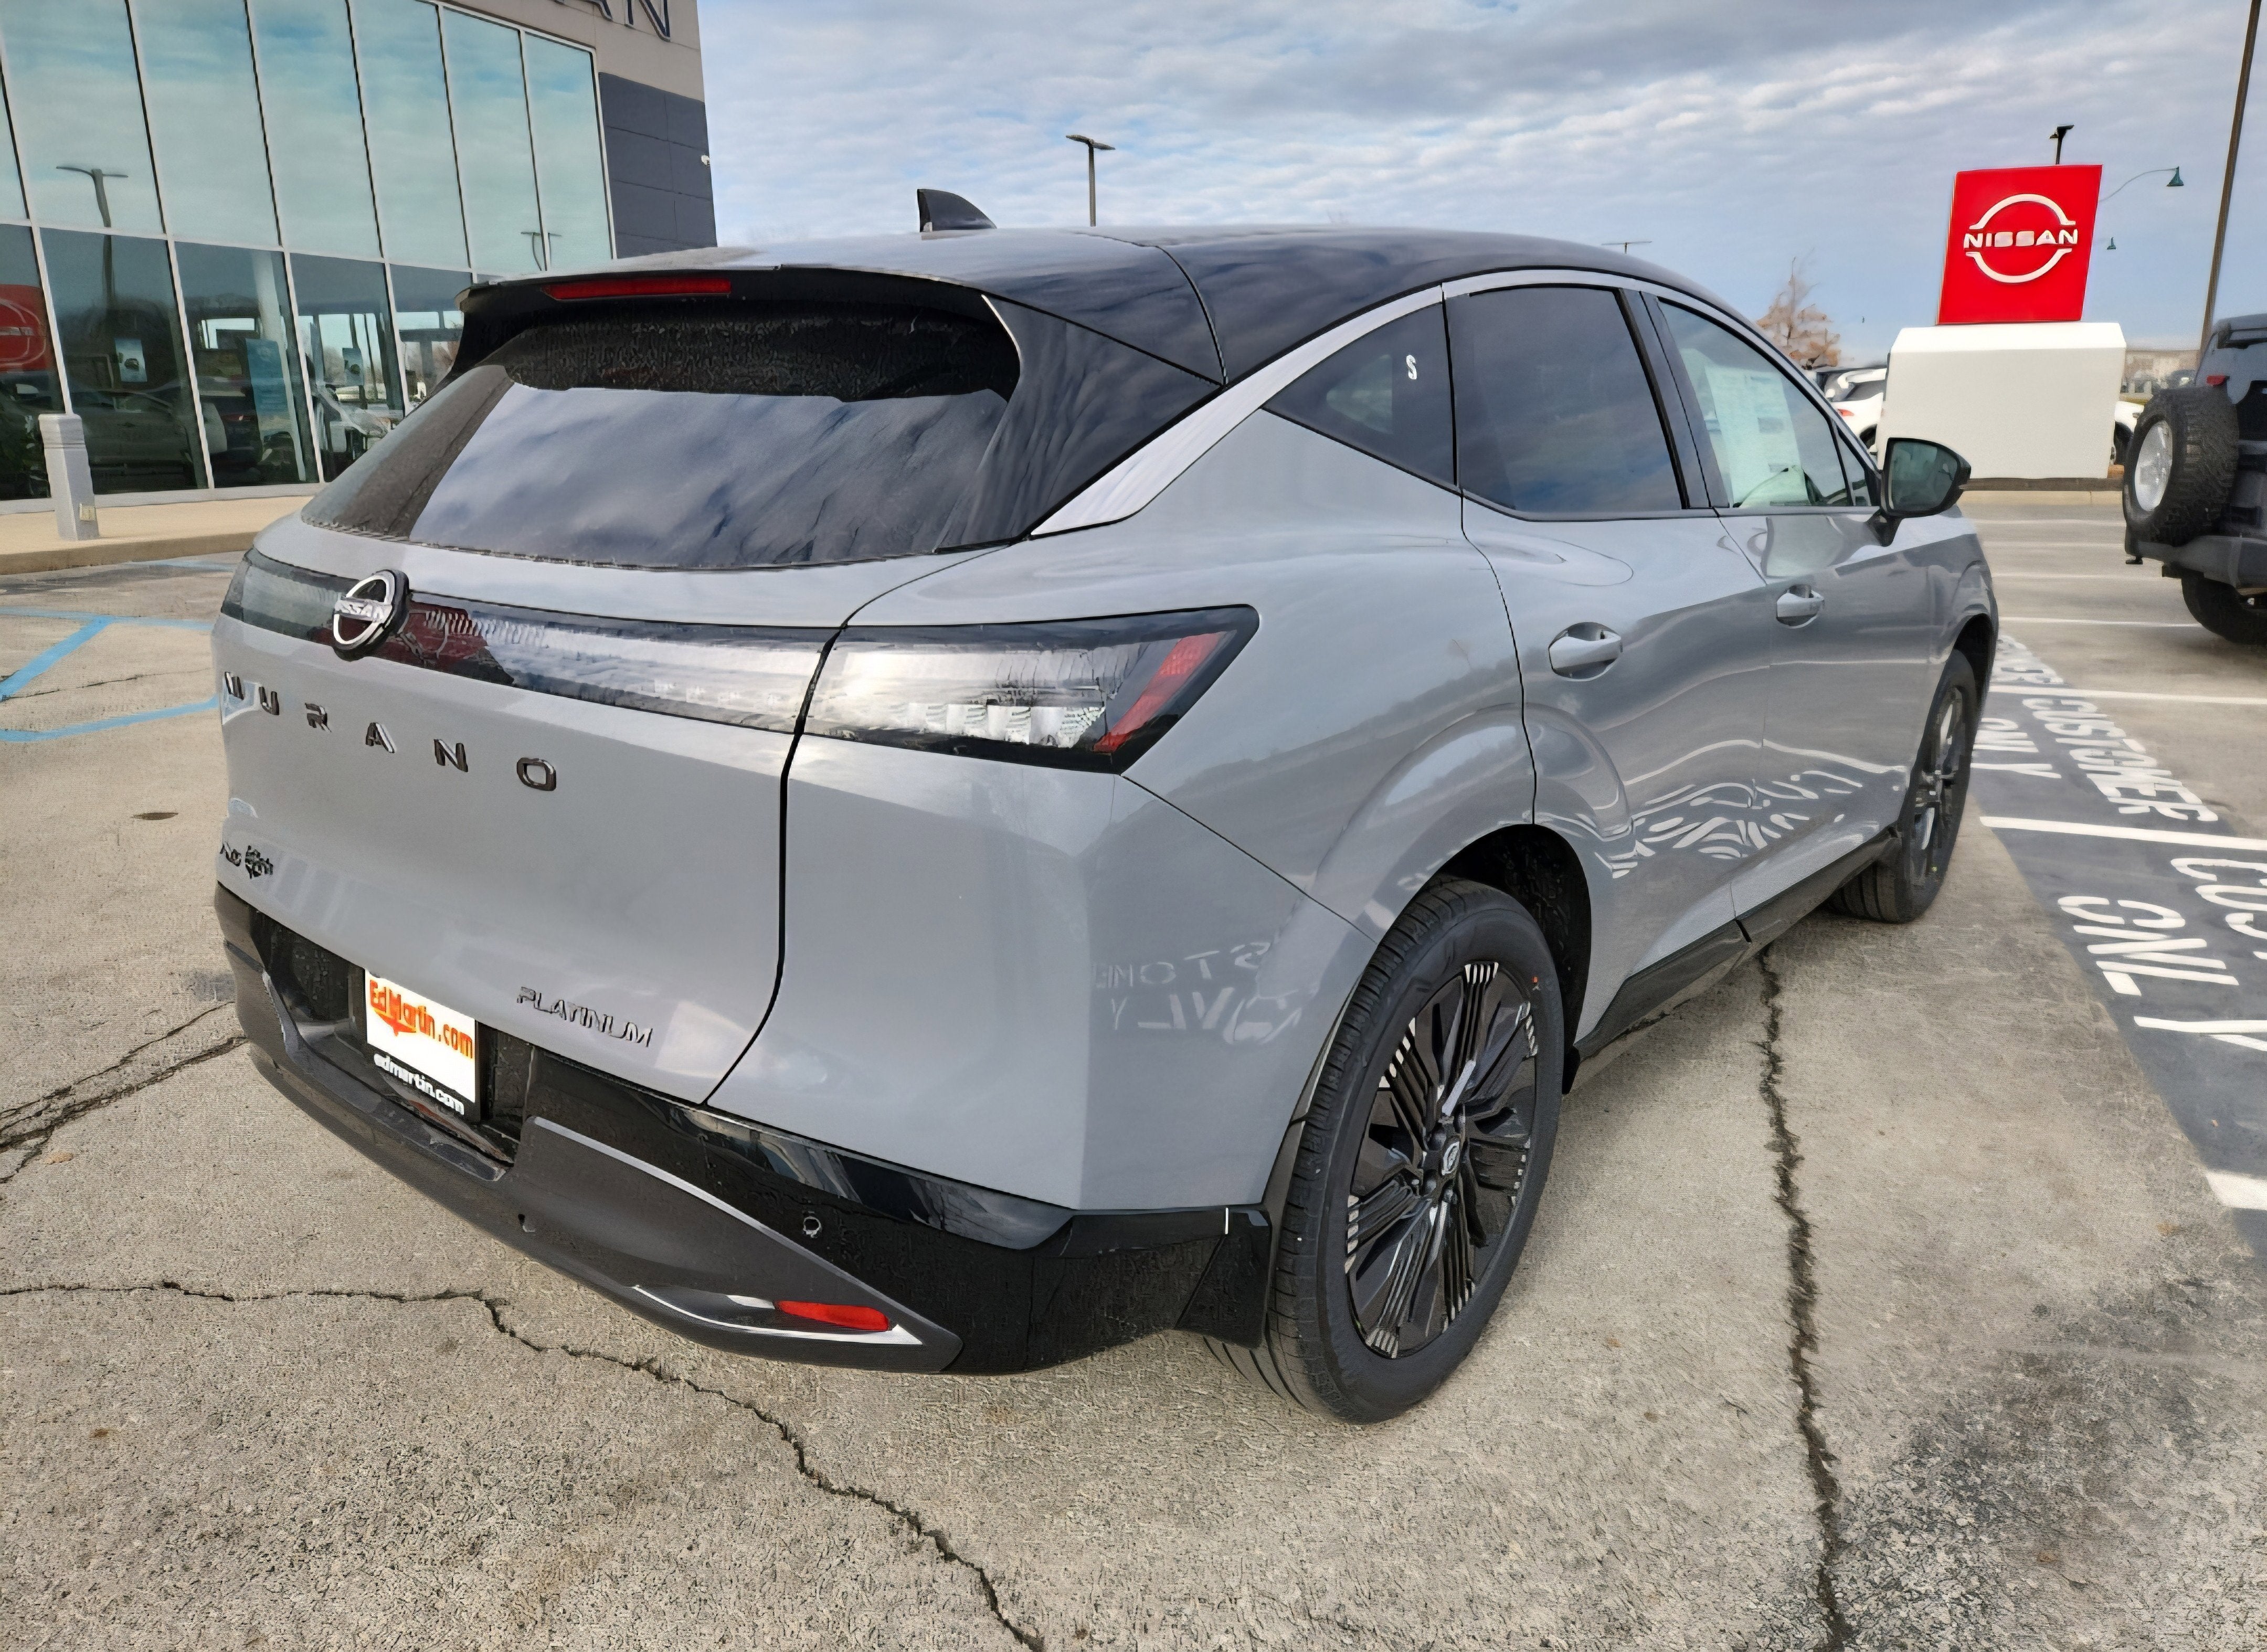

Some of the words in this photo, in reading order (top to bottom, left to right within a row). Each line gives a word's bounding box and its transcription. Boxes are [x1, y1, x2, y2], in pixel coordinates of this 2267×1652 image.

[1963, 228, 2078, 249] NISSAN
[2021, 697, 2219, 822] CUSTOMER
[516, 986, 653, 1048] PLATINUM
